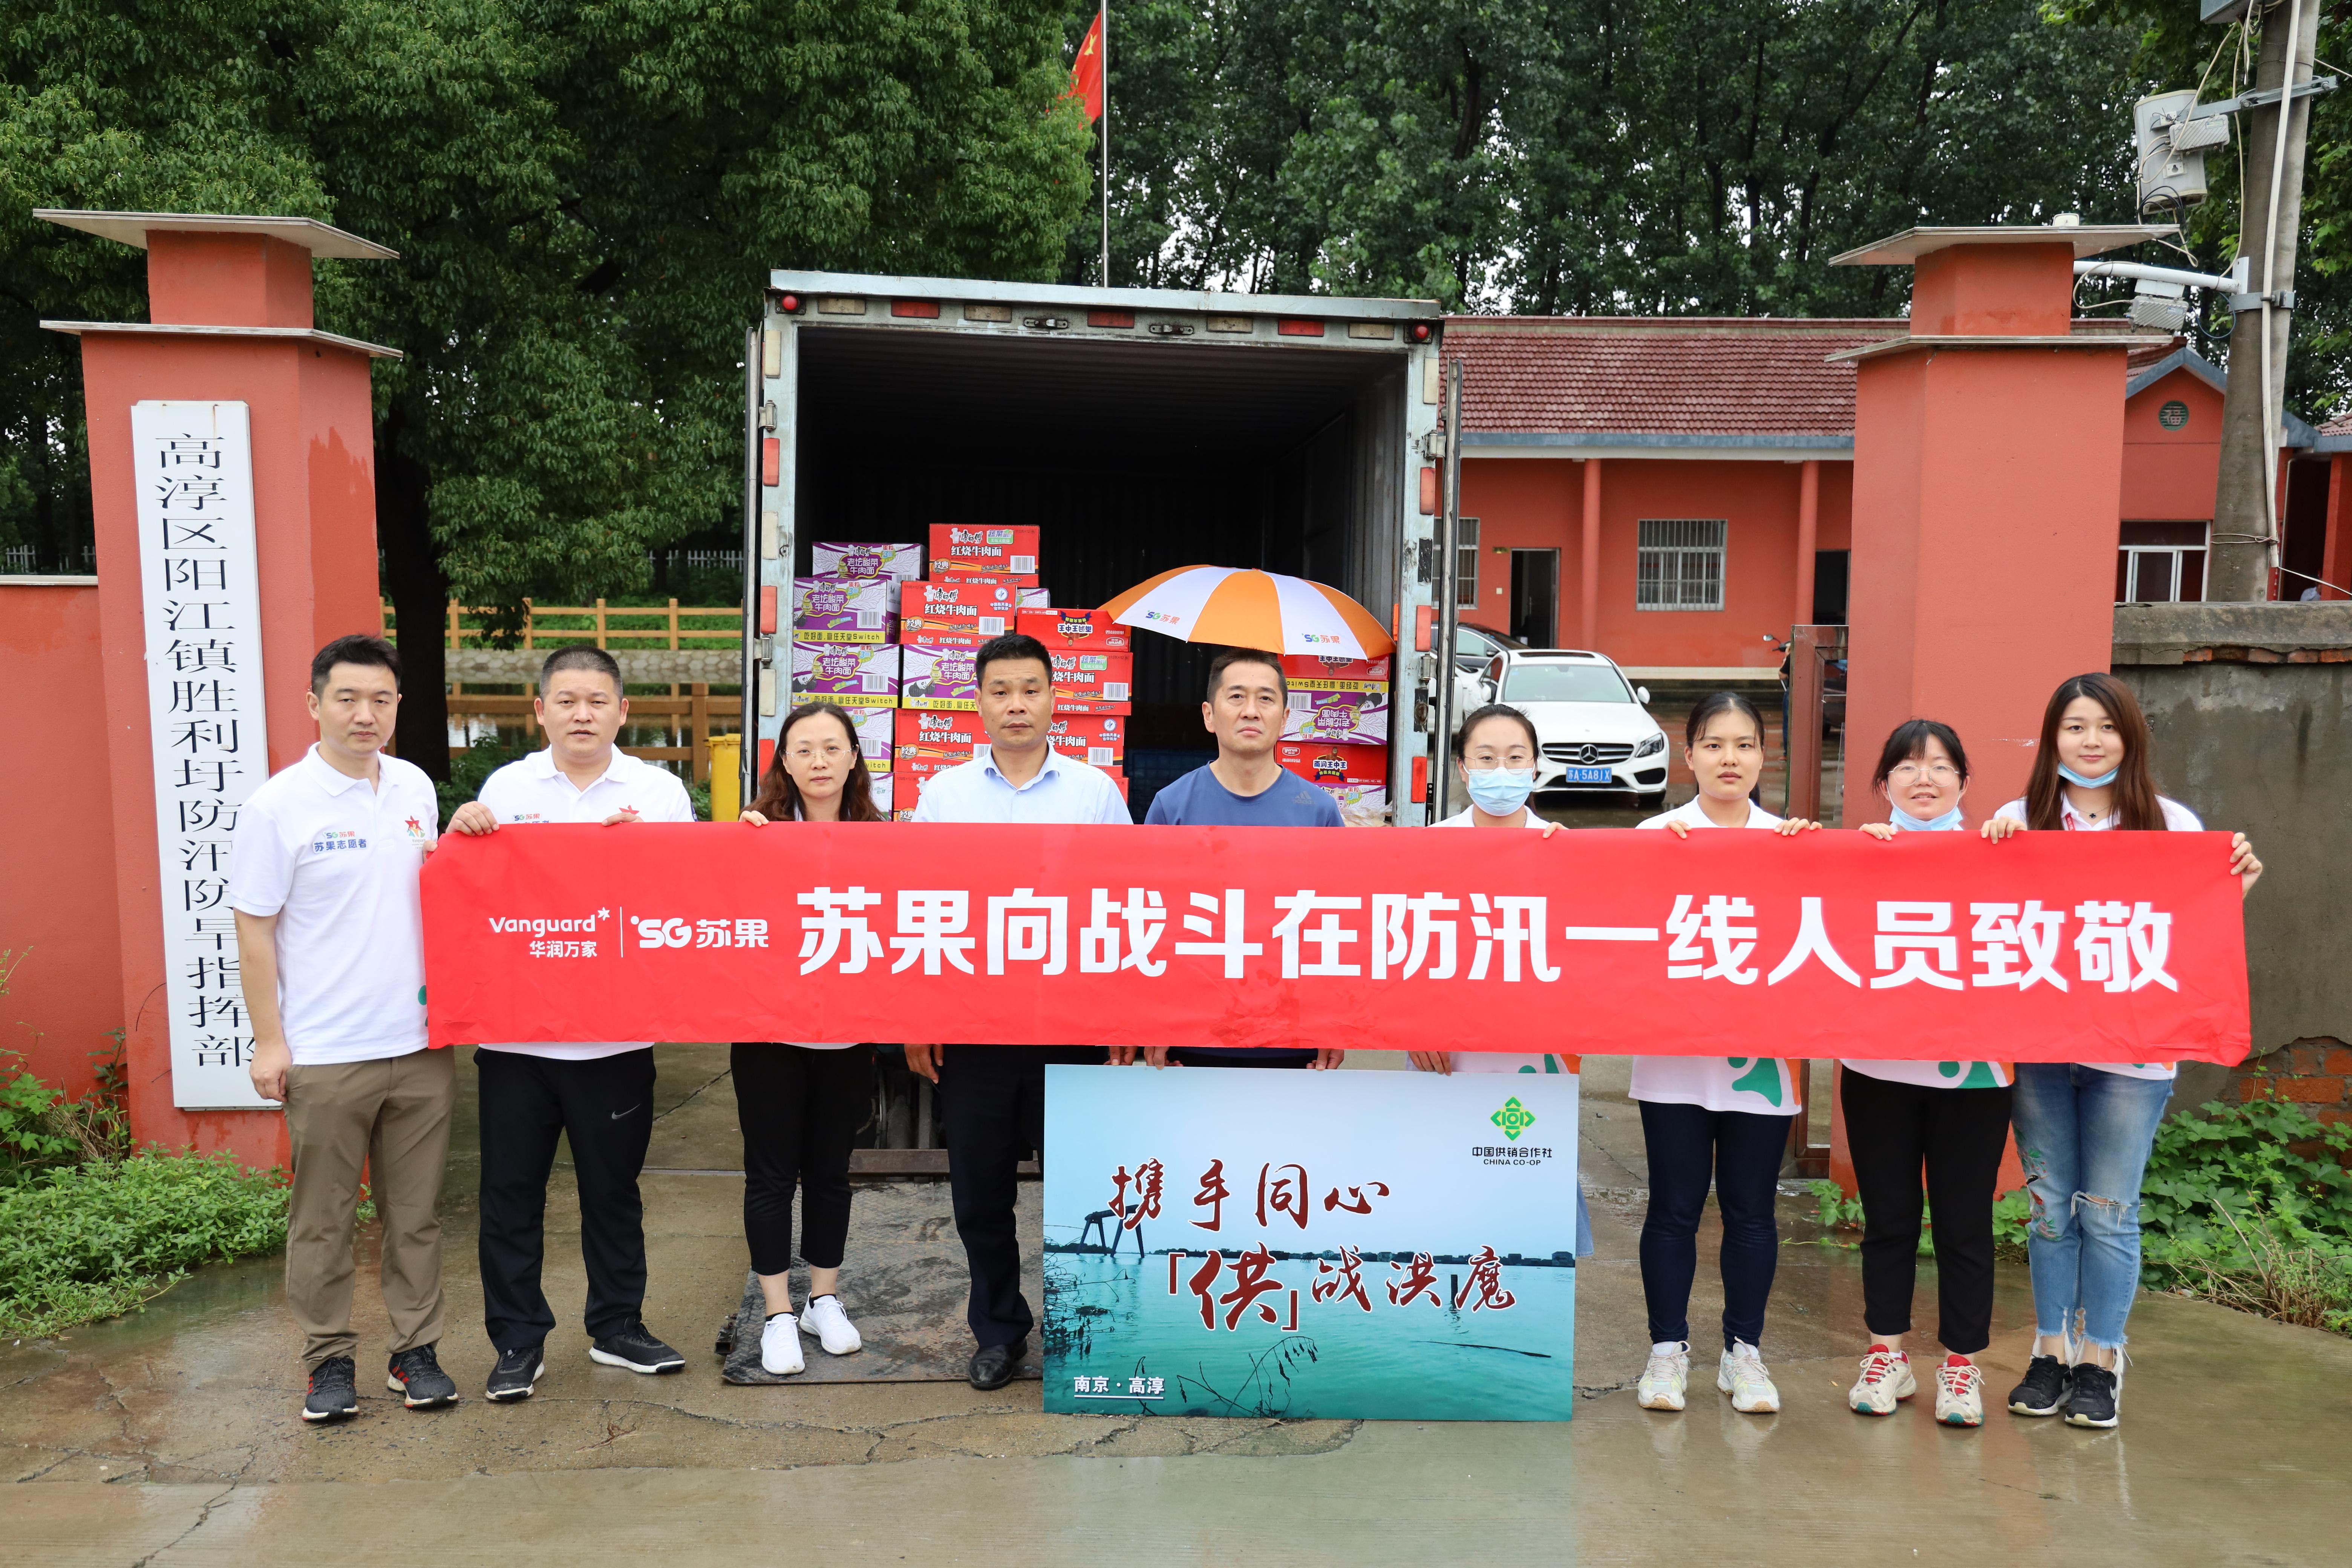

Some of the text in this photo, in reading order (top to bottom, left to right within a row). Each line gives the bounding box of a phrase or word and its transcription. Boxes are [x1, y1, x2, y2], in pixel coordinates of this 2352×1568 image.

[951, 545, 1002, 557] 红烧牛肉面
[847, 557, 879, 567] 老坛酸菜
[934, 560, 949, 569] 经典
[812, 594, 844, 603] 老坛酸菜
[815, 603, 840, 612] 牛肉面
[924, 603, 978, 617] 红烧牛肉面
[906, 619, 922, 628] 经典
[939, 637, 972, 645] 红烧牛肉面
[822, 657, 856, 667] 老坛酸菜
[941, 662, 974, 672] 老坛酸菜
[825, 667, 851, 675] 牛肉面
[944, 672, 970, 680] 牛肉面
[1051, 671, 1095, 683] 烧牛肉面
[1321, 709, 1348, 718] 牛肉面
[1317, 717, 1350, 727] 老坛酸菜
[919, 731, 972, 744] 红烧牛肉面
[901, 746, 917, 755] 经典
[314, 838, 367, 852] 苏果志愿者
[489, 914, 596, 938] Vanguard
[796, 886, 2179, 994] 苏果向战斗在防汛一线人员致敬
[529, 941, 597, 958] 华润万家
[1472, 1147, 1552, 1158] 中国供销合作社
[1108, 1158, 1390, 1231] 携手同心
